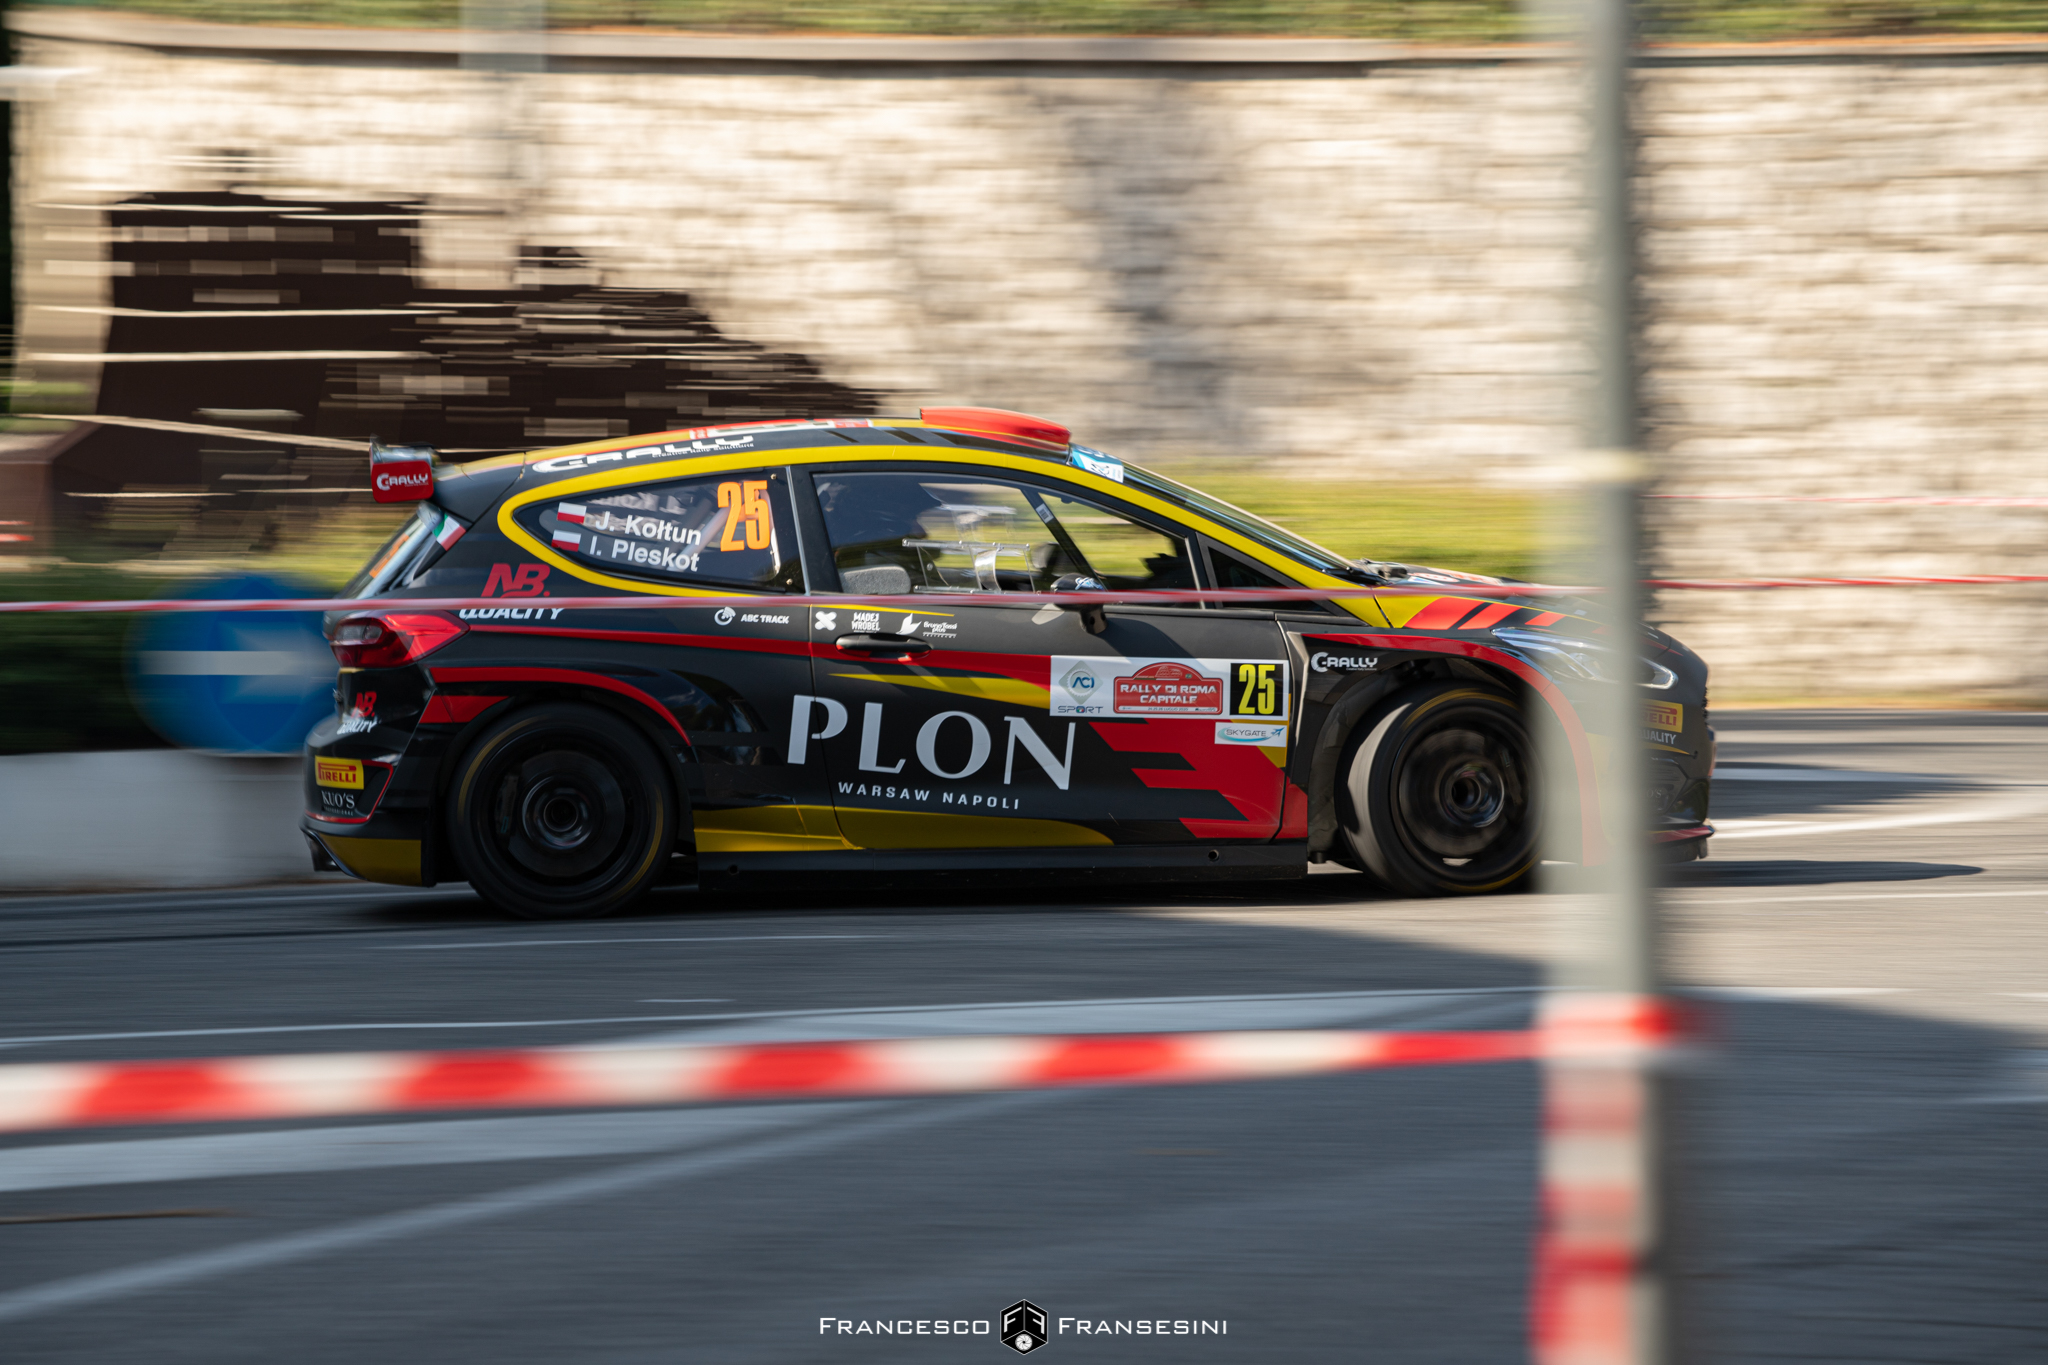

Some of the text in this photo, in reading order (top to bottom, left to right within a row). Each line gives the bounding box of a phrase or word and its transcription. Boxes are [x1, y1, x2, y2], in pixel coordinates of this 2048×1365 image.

[717, 480, 771, 552] 25
[595, 510, 702, 546] J. Kołtun
[611, 539, 700, 573] Pleskot
[740, 613, 790, 624] ABC TRACK
[853, 612, 880, 622] MADEJ
[1071, 676, 1095, 689] ACI
[1120, 684, 1218, 694] RALLY DI ROMA
[1238, 663, 1276, 715] 25
[1139, 694, 1198, 704] CAPITALE
[1057, 705, 1104, 714] SPORT
[787, 694, 1076, 790] PLON
[1226, 728, 1267, 738] SKYGATE
[317, 762, 357, 783] PIRELLI
[321, 790, 355, 809] KUO'S
[838, 782, 1020, 810] WARSAW NAPOLI
